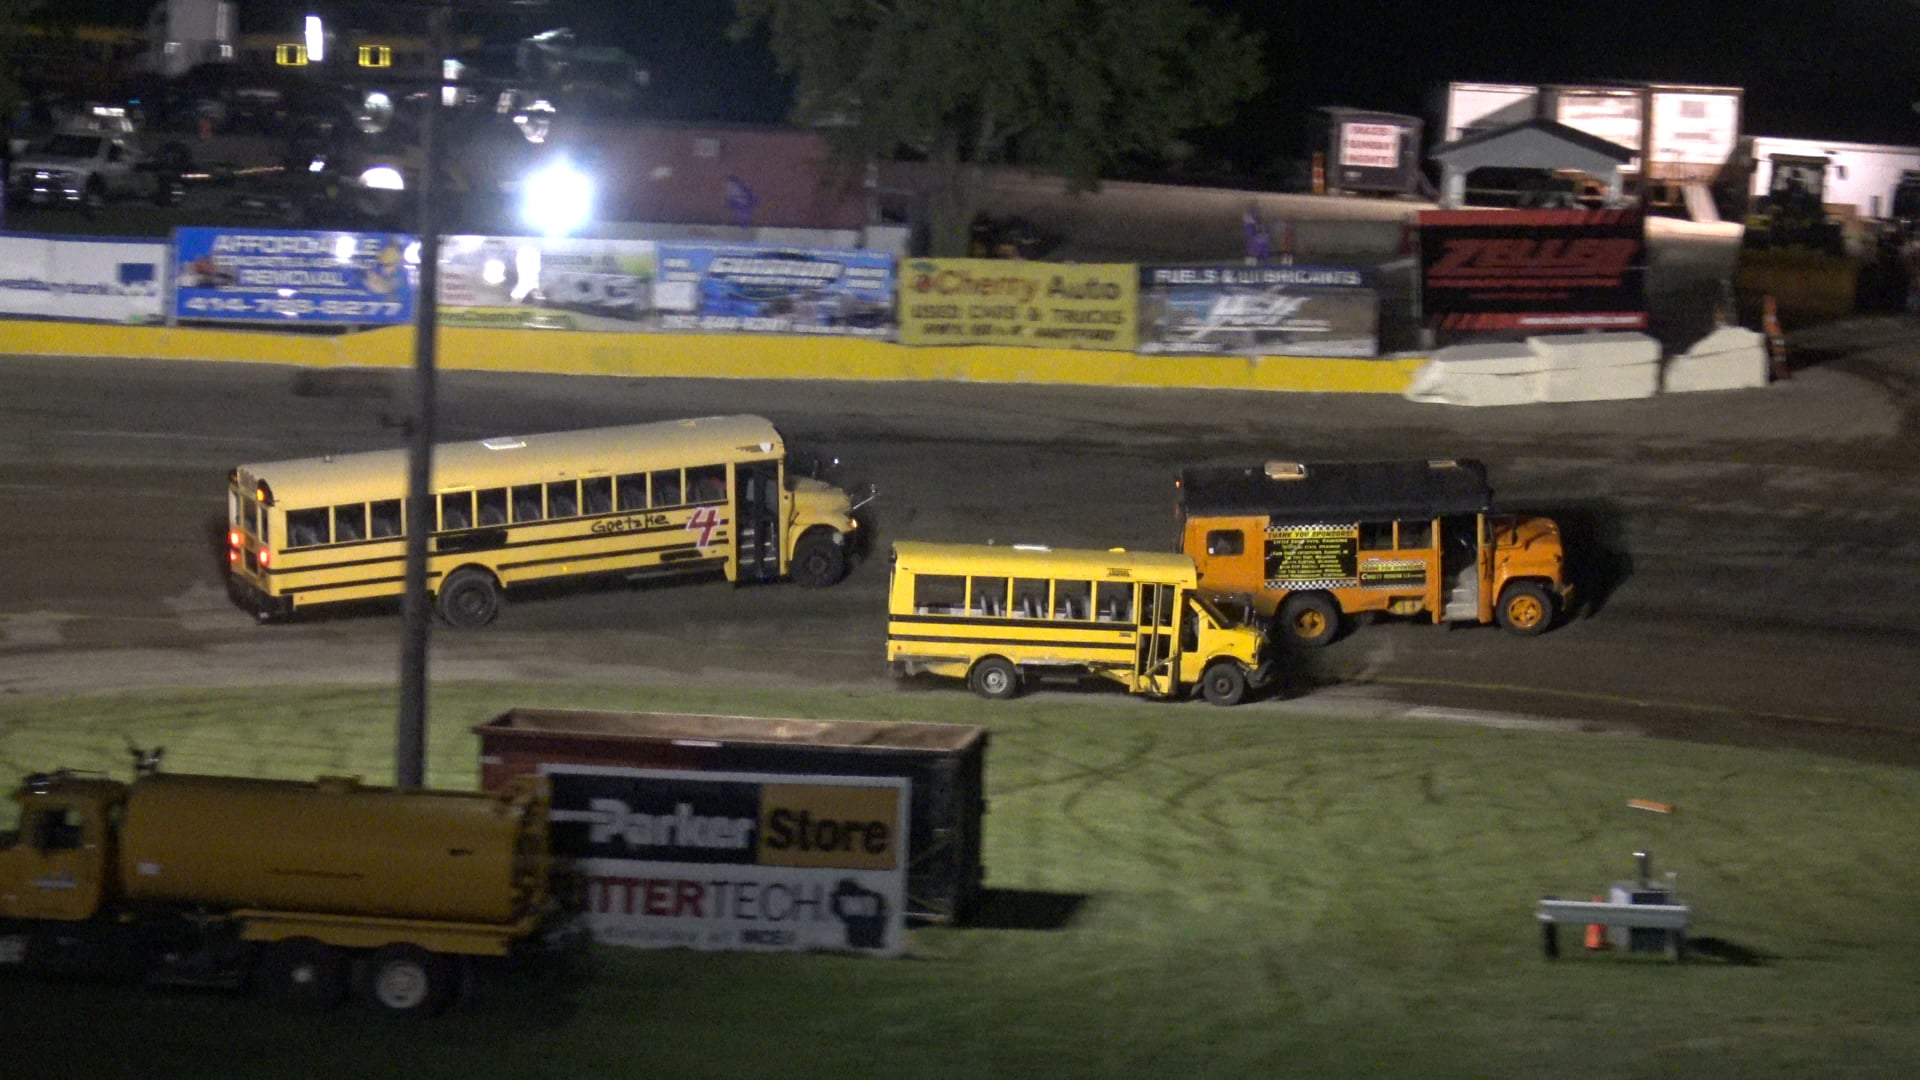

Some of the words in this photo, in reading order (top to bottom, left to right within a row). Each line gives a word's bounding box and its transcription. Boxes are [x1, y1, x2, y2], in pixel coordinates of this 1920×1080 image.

[213, 236, 381, 256] AFFORDAE
[936, 270, 1040, 303] Cherry
[1047, 274, 1121, 300] Auto
[1155, 269, 1217, 283] FUELS
[1239, 271, 1361, 285] LUBRICANTS
[911, 304, 958, 319] USED
[968, 305, 1017, 320] CARS
[1052, 308, 1126, 324] TRUCKS
[591, 513, 669, 535] Goetzke
[686, 506, 721, 549] 4
[1268, 531, 1292, 539] THANK
[588, 799, 756, 849] Parker
[767, 808, 888, 854] Store
[592, 876, 826, 921] TTERTECH
